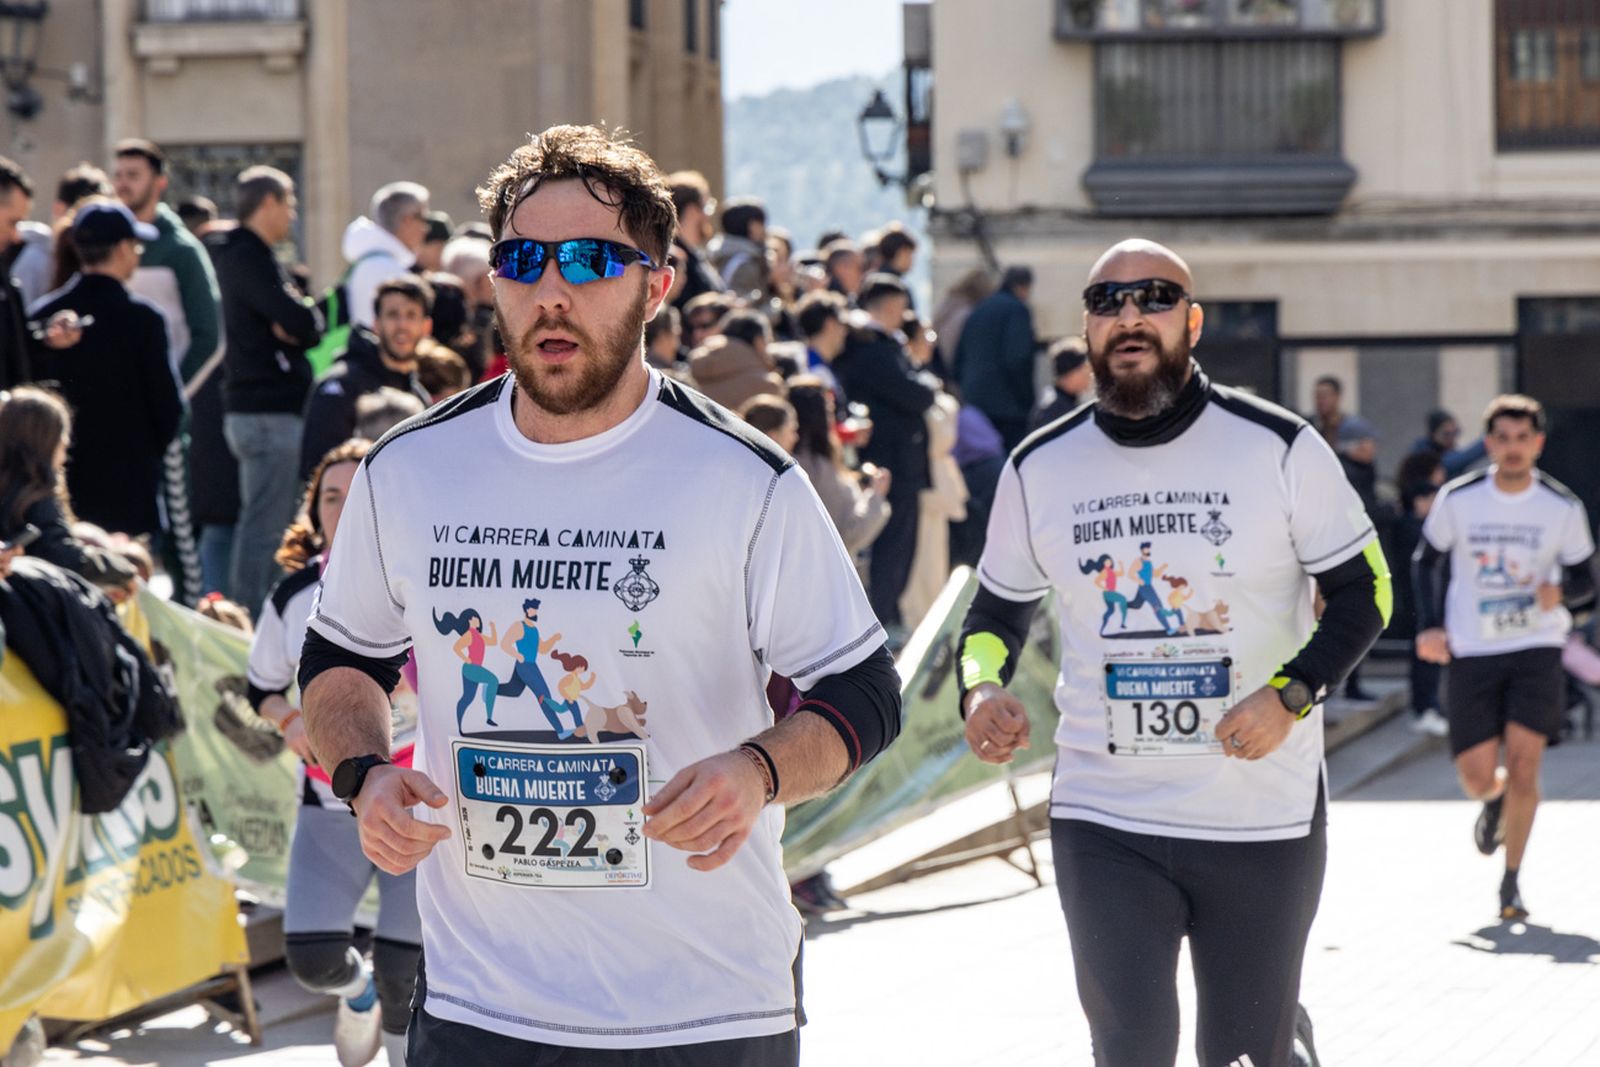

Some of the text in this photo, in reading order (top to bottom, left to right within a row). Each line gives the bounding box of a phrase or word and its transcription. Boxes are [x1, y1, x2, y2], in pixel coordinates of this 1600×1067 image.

[1073, 491, 1230, 515] VI CARRERA CAMINATA
[433, 525, 666, 550] VI CARRERA CAMINATA
[1074, 513, 1197, 544] BUENA MUERTE
[429, 557, 612, 591] BUENA MUERTE
[1126, 667, 1167, 677] CARRERA
[1168, 665, 1217, 677] CAMINATA
[1116, 680, 1196, 697] BUENA MUERTE
[1132, 700, 1200, 736] 130
[489, 757, 544, 773] CARRERA
[547, 758, 616, 774] CAMINATA
[476, 776, 586, 801] BUENA MUERTE
[495, 805, 599, 858] 222
[513, 857, 537, 867] PABLO
